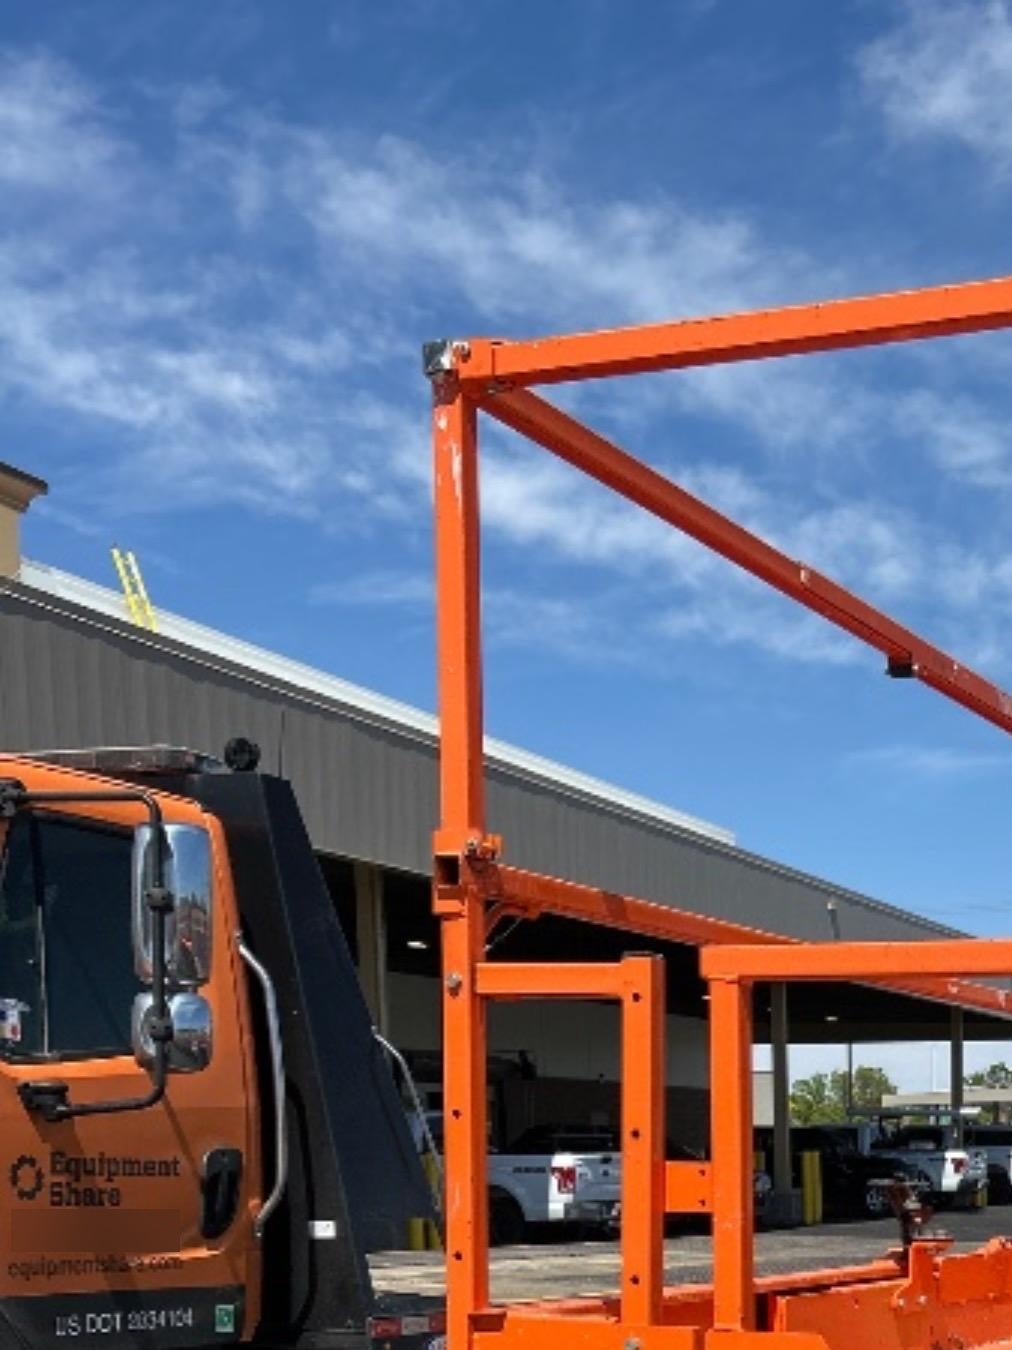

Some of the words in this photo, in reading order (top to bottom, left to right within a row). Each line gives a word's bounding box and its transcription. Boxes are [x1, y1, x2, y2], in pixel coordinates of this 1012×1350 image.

[50, 1150, 181, 1181] Equipment
[49, 1181, 121, 1207] Share
[55, 1314, 82, 1336] US
